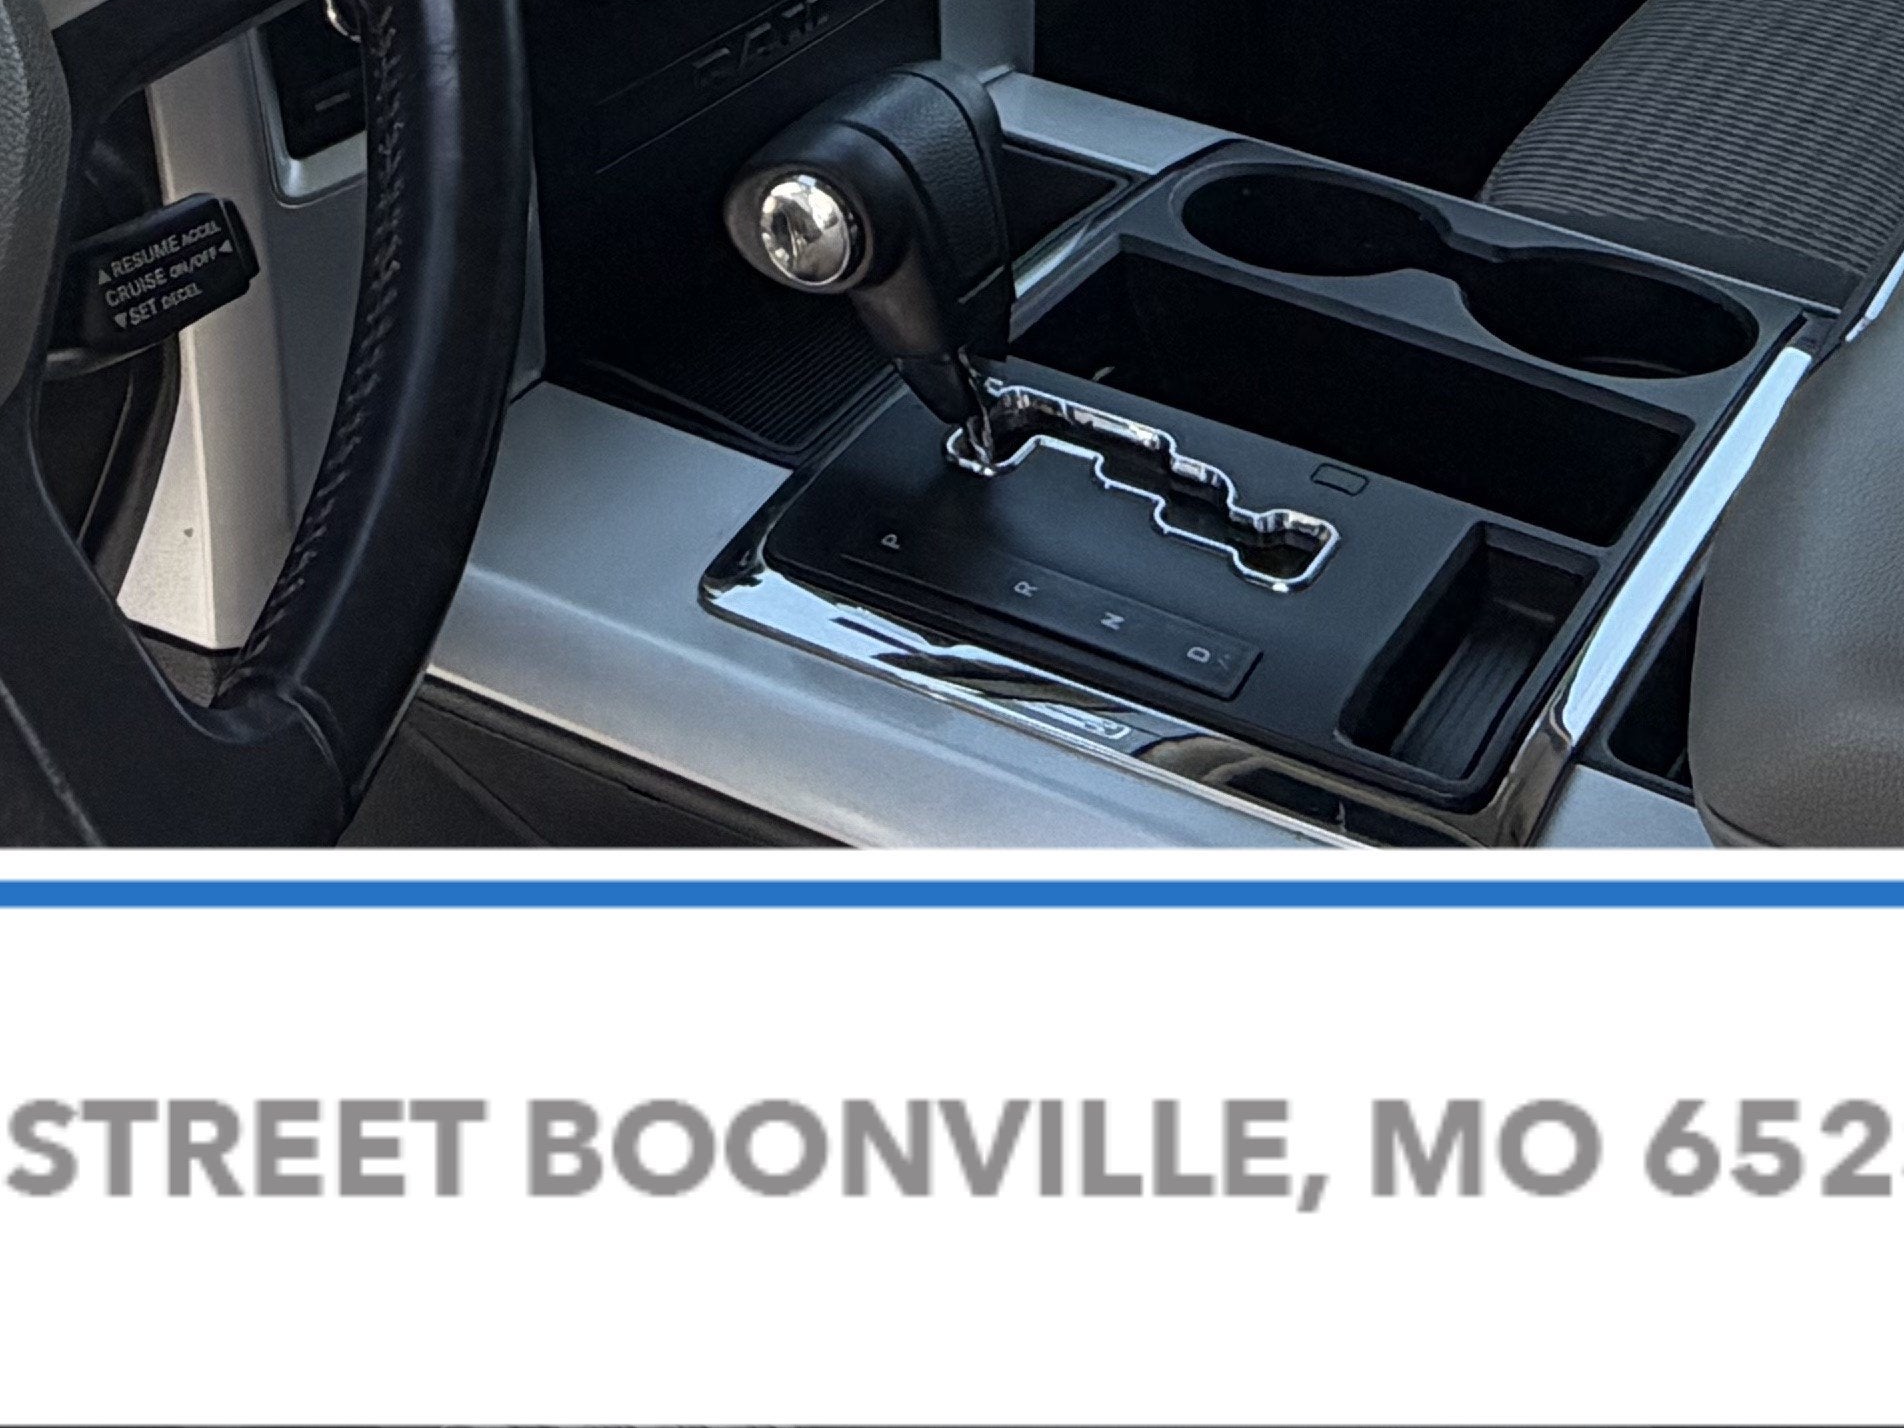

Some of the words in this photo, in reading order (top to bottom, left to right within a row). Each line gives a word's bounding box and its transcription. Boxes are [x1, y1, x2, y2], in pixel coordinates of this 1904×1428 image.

[110, 234, 180, 278] RESUME
[181, 219, 222, 247] ACCEL
[104, 266, 168, 308] CRUISE
[128, 297, 158, 326] SET
[161, 281, 204, 311] DECEL
[880, 532, 901, 551] P
[1012, 579, 1040, 599] R
[1098, 610, 1126, 632] N
[1185, 645, 1213, 664] D
